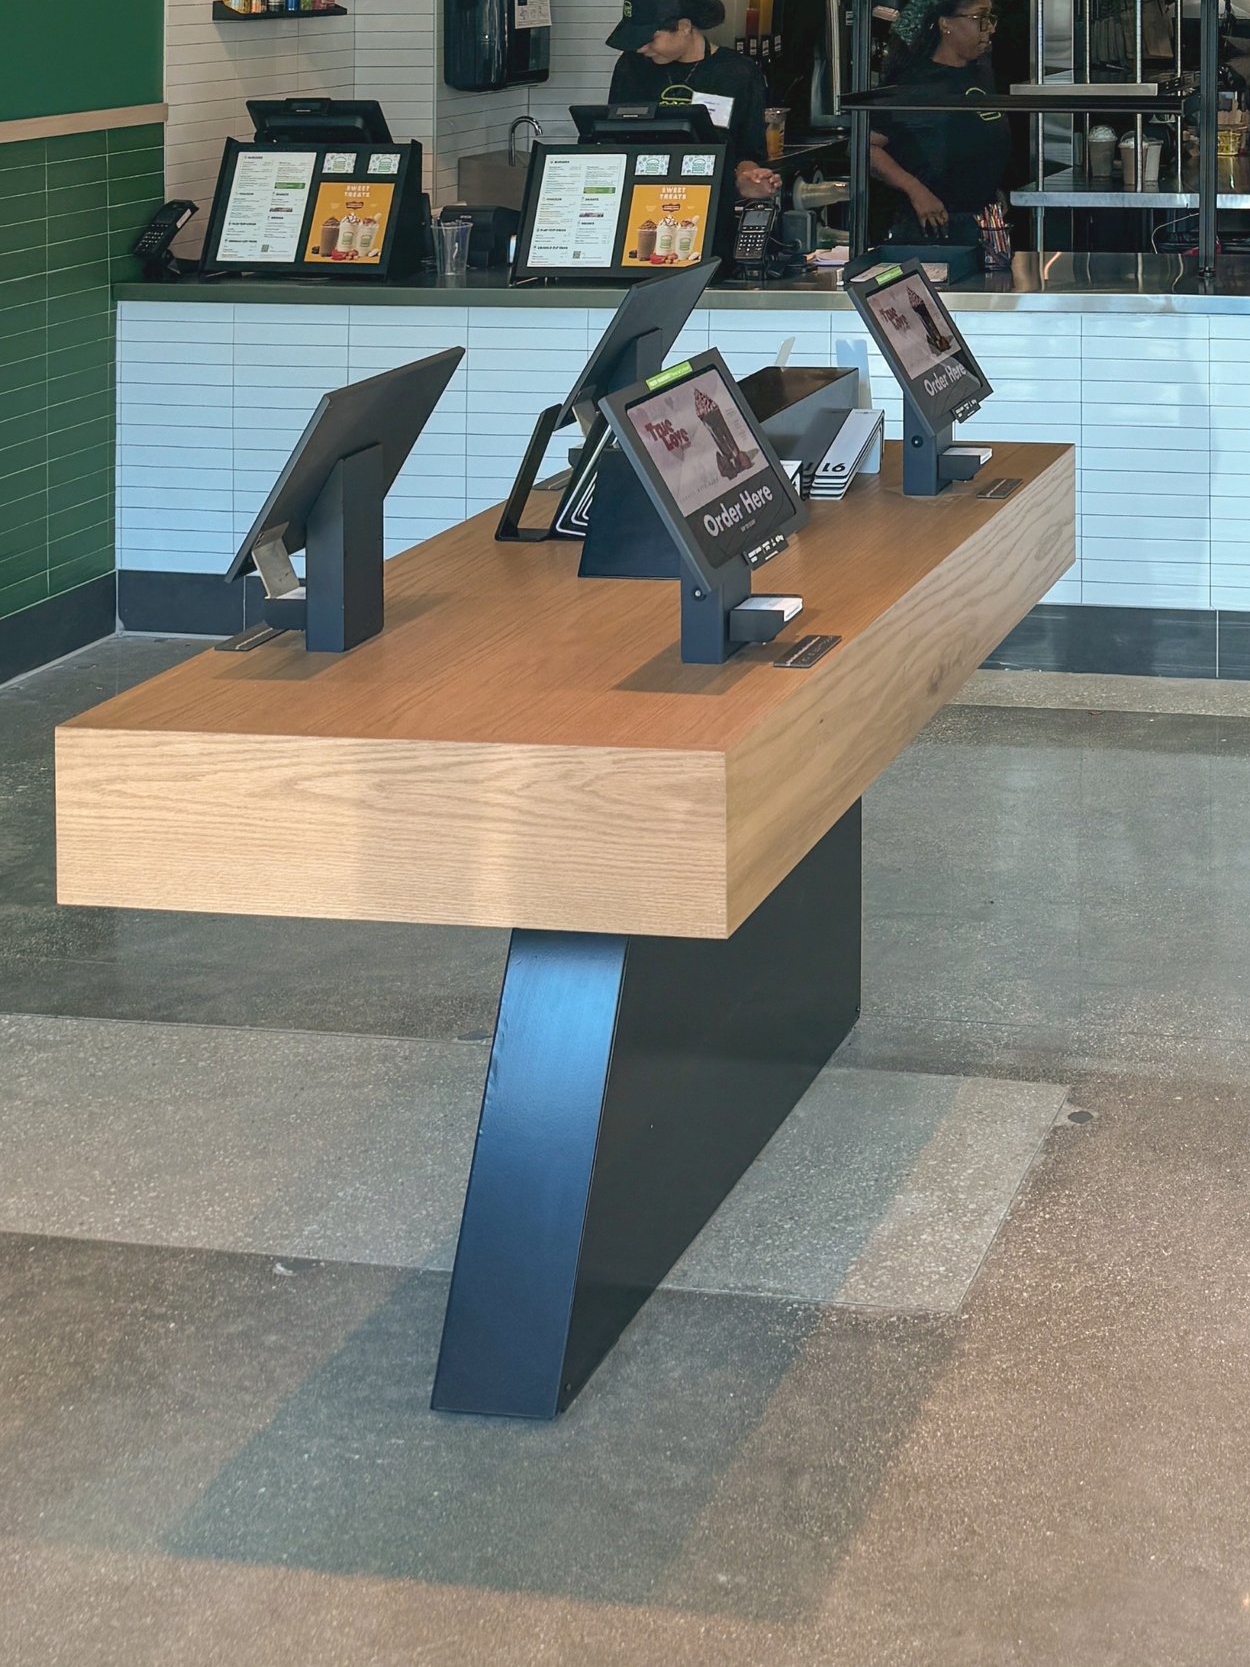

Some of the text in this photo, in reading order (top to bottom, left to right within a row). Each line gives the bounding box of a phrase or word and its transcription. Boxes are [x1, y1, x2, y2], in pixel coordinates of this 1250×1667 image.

[923, 363, 968, 397] Order Here
[702, 484, 773, 538] Order Here
